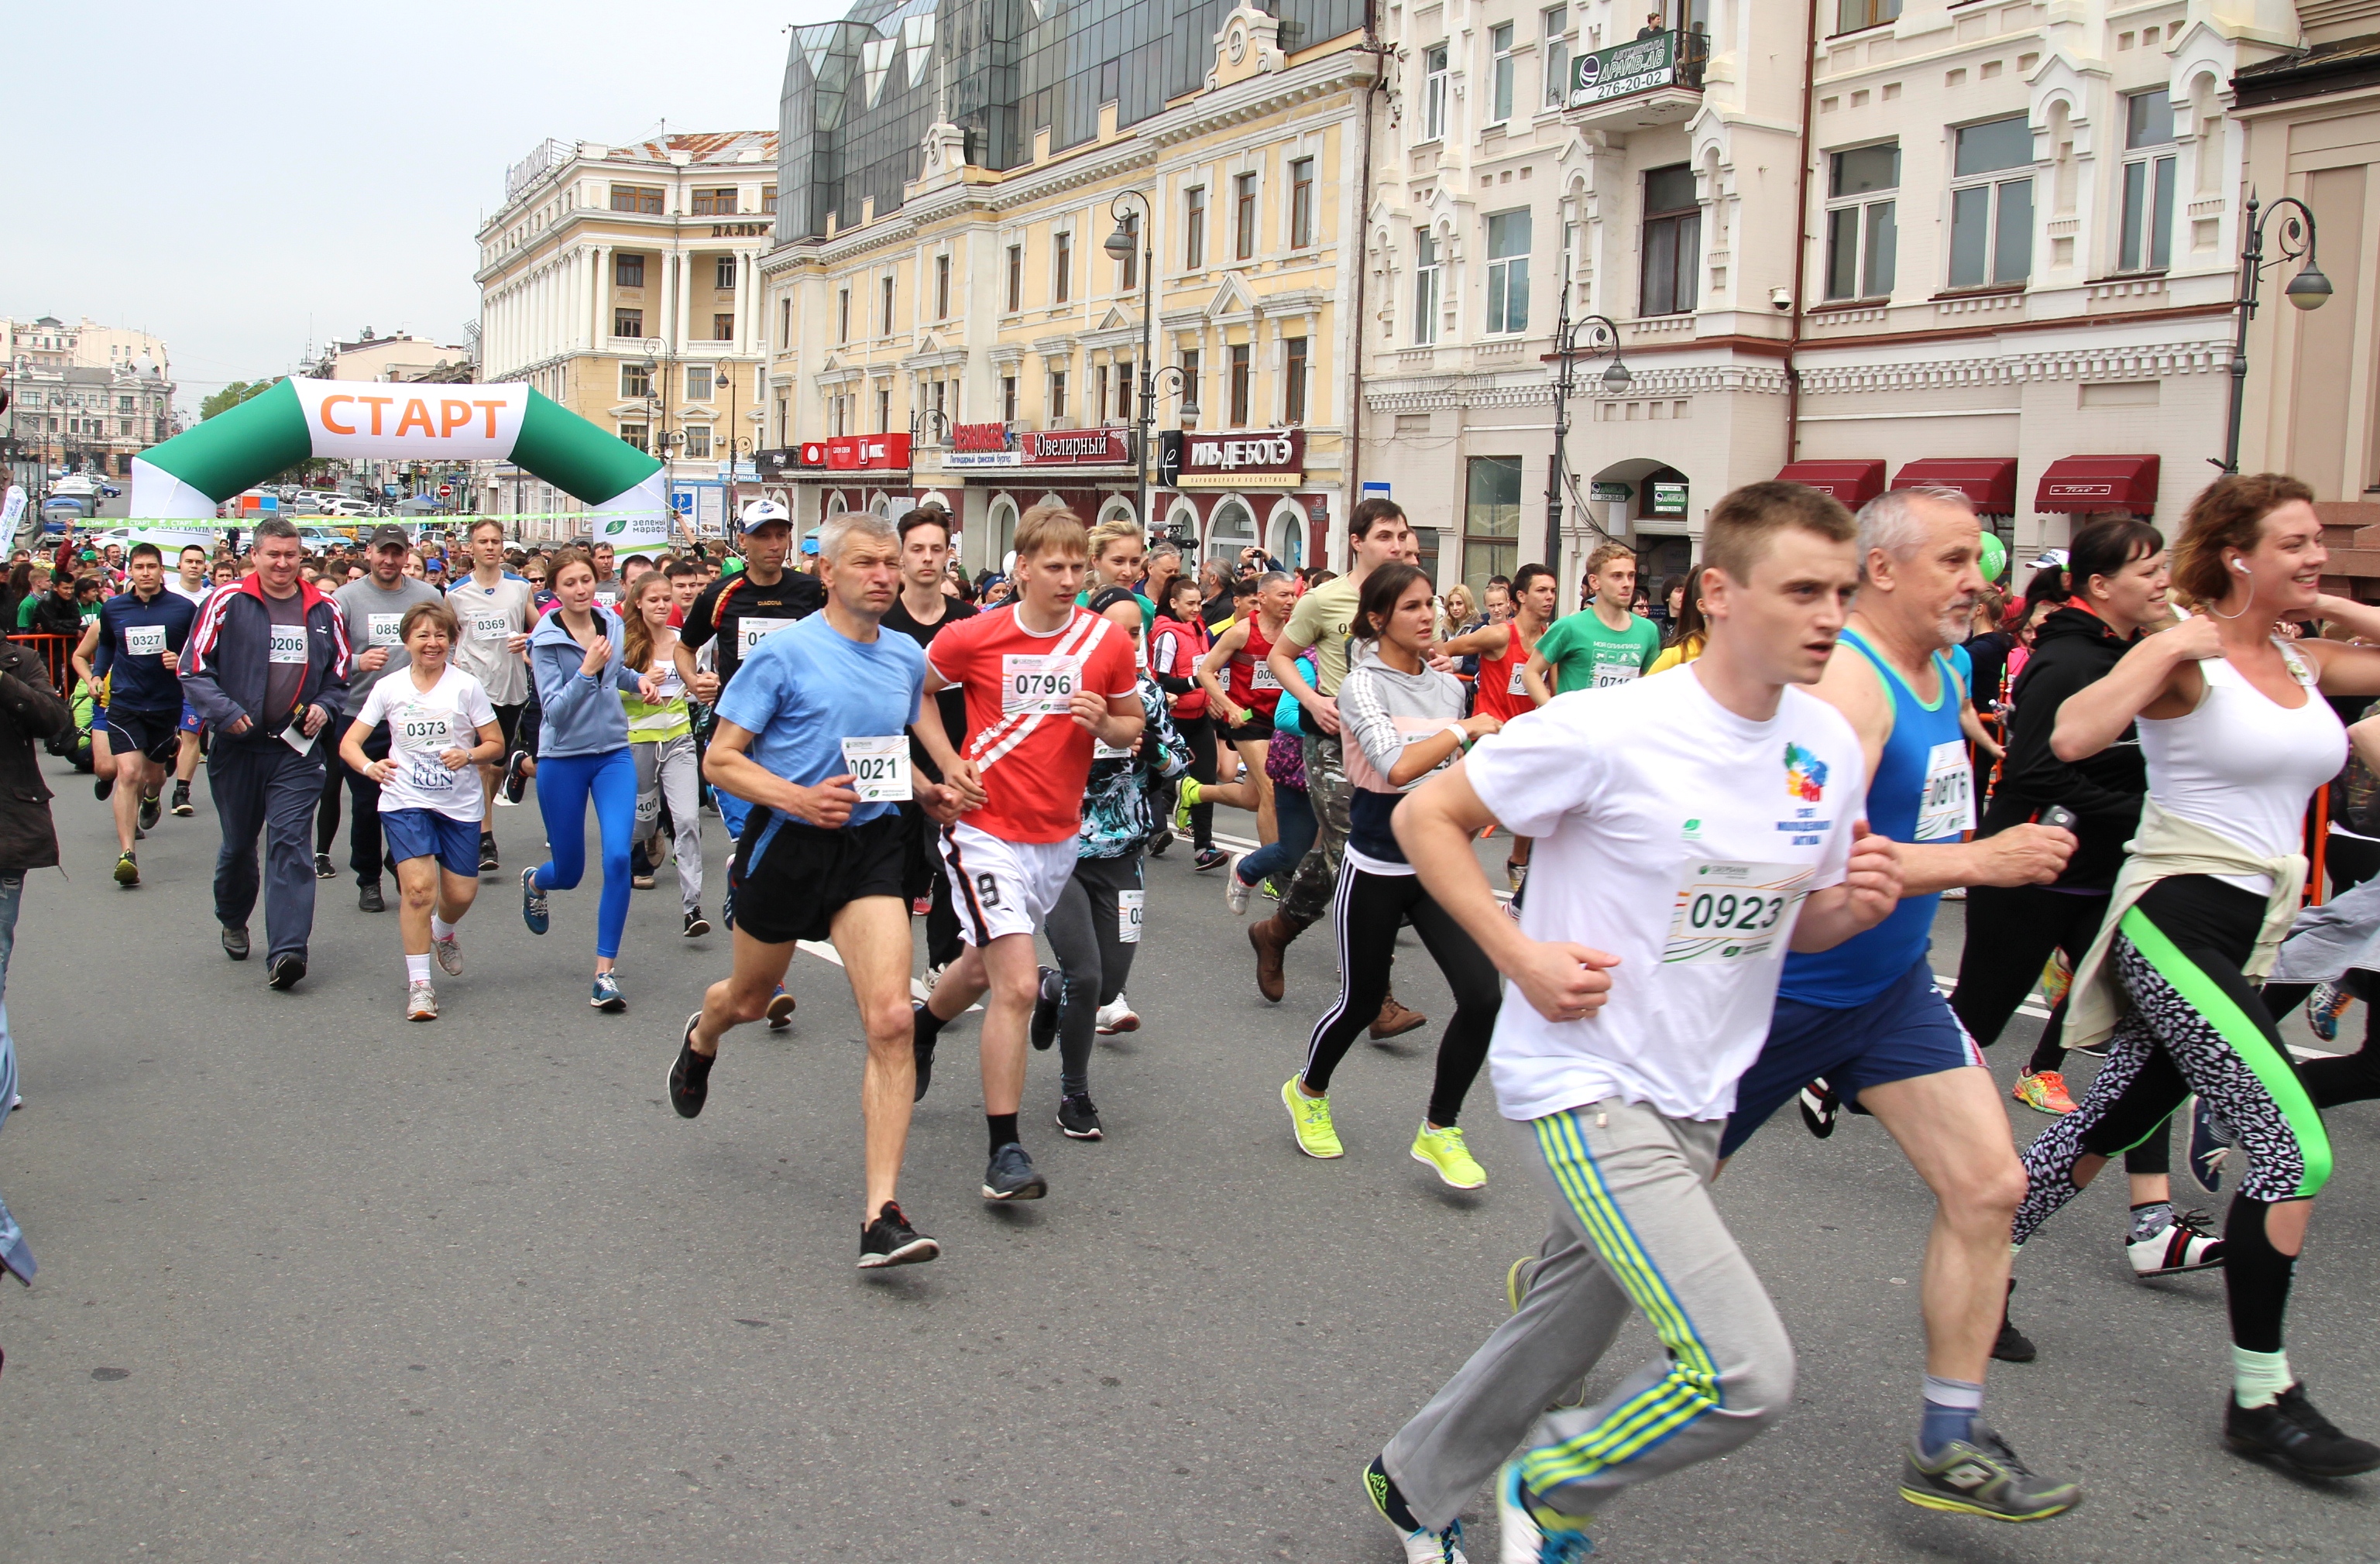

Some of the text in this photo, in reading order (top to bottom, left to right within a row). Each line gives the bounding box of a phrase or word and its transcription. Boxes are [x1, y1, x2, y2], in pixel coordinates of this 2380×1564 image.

[1611, 39, 1664, 62] АВТОШКОЛА
[1599, 49, 1664, 84] ДРАЙВ-ДВ
[1598, 71, 1662, 98] 276-20-02
[320, 395, 507, 438] СТАРТ
[953, 422, 1005, 451] HESBURGER
[1034, 430, 1107, 462] Ювелирный
[950, 454, 1011, 465] Легендарный финский бургер
[376, 624, 400, 635] 085
[478, 619, 505, 630] 0369
[132, 635, 160, 646] 0327
[270, 637, 303, 650] 0206
[1015, 675, 1071, 695] 0796
[1600, 676, 1630, 688] 071
[407, 722, 446, 736] 0373
[413, 772, 452, 787] RUN
[850, 758, 896, 780] 0021
[977, 873, 999, 909] 9
[1691, 893, 1783, 930] 0923
